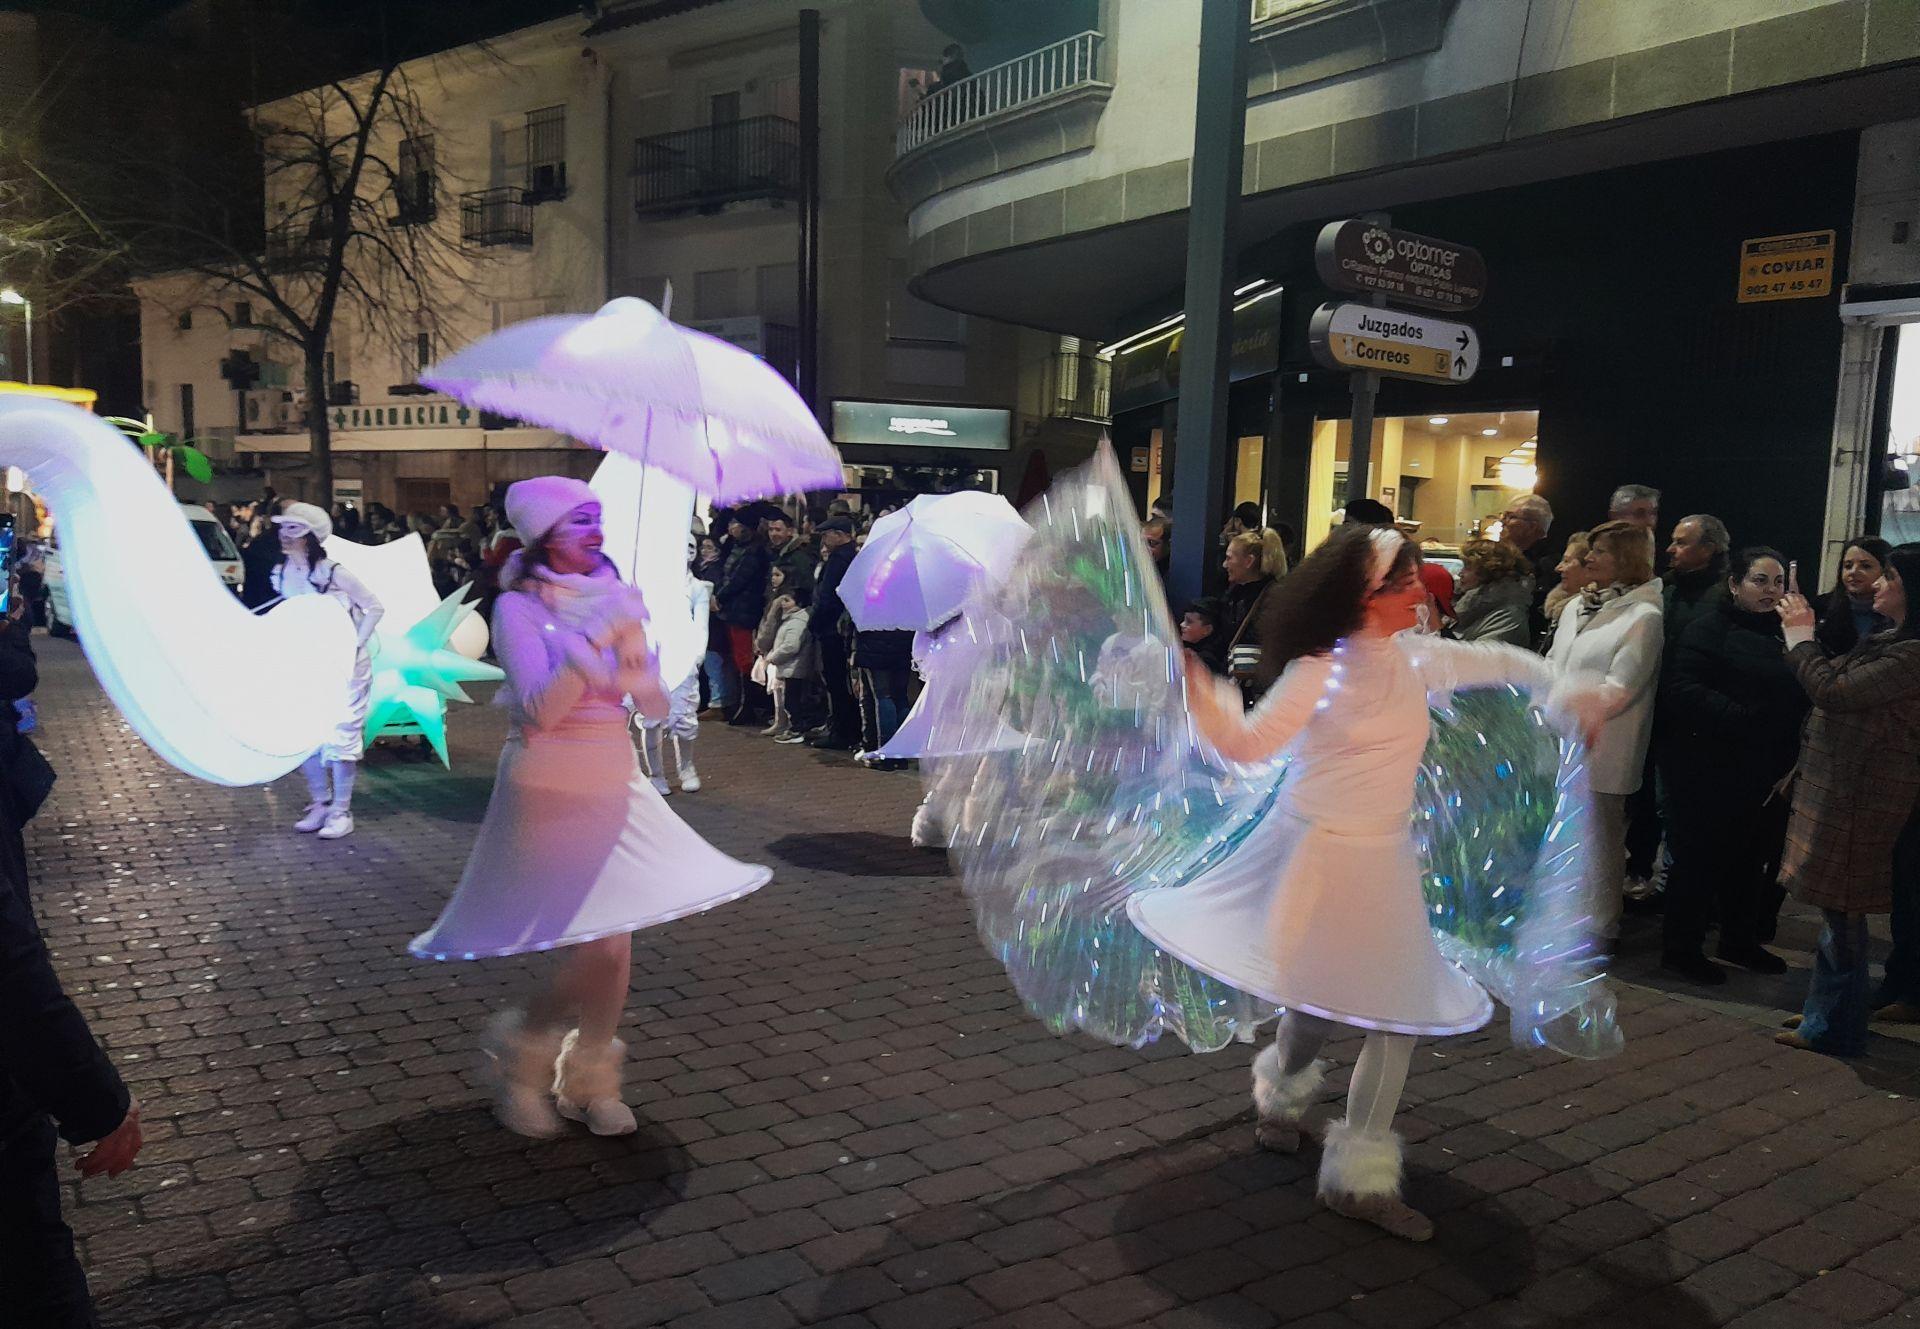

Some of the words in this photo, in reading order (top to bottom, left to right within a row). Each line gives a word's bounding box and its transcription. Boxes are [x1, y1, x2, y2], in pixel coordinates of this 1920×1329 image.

[1397, 239, 1460, 268] optomer
[1410, 261, 1452, 281] ÓPTICAS
[1761, 258, 1825, 275] COVIAR
[1357, 314, 1424, 339] Juzgados
[1356, 341, 1411, 365] Correos
[352, 405, 449, 427] FARMACIA
